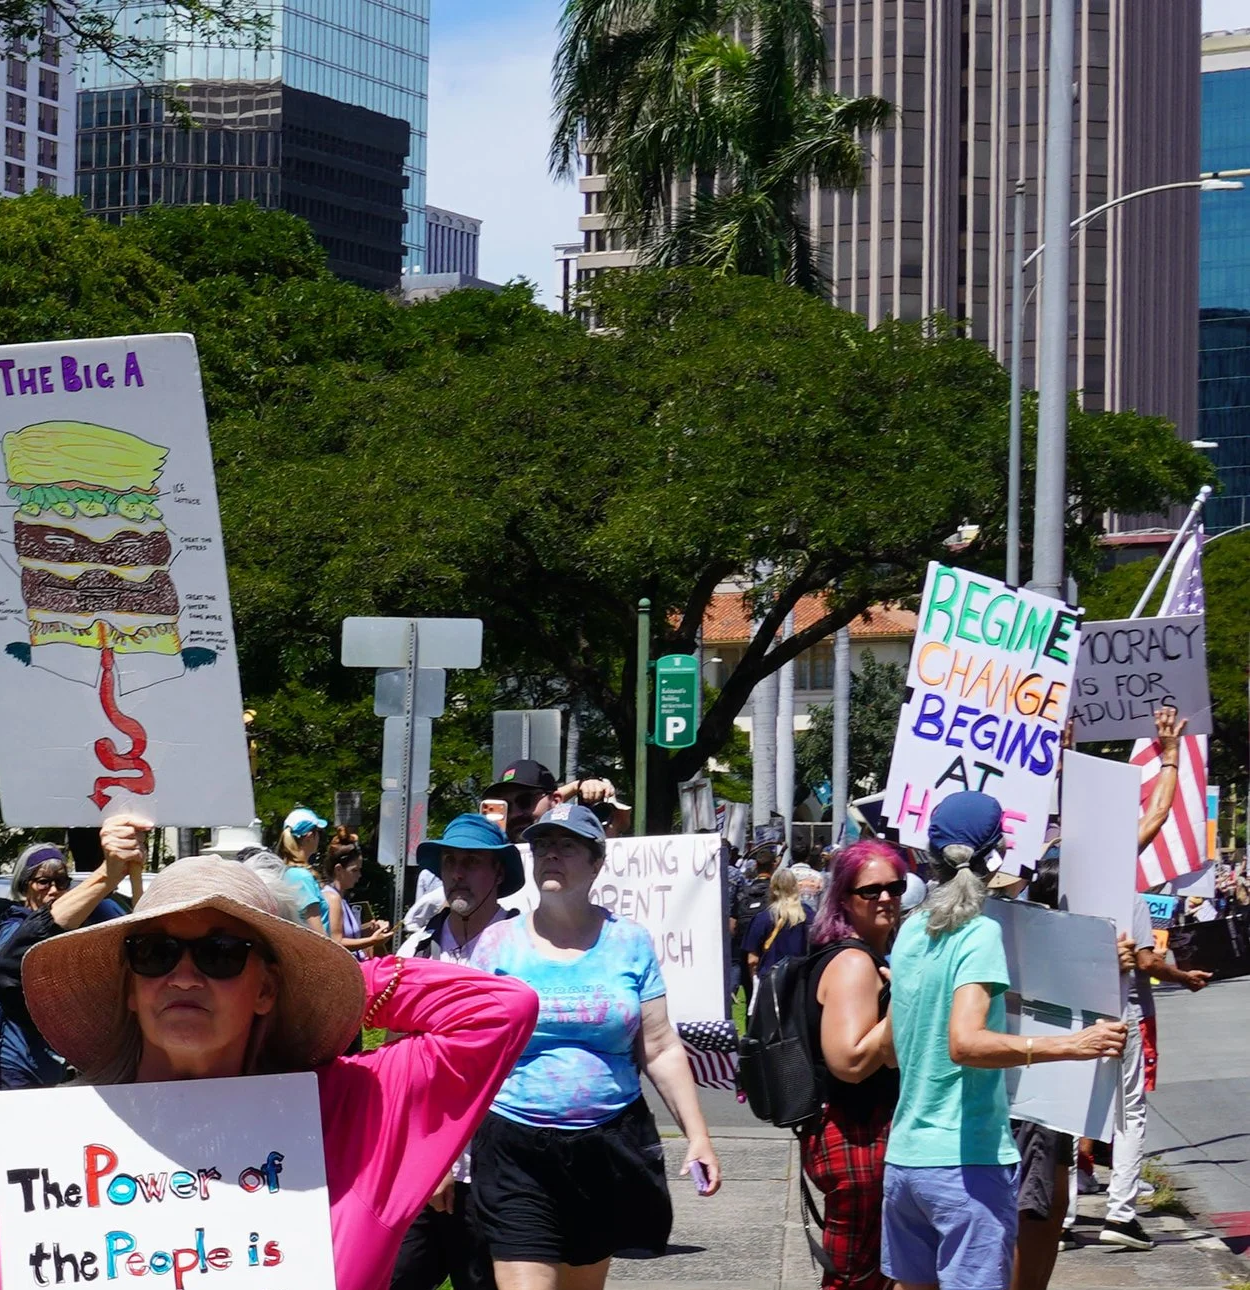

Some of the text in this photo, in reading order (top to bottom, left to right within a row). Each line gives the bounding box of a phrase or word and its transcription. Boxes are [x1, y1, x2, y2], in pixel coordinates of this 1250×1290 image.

[61, 355, 115, 393] BIG
[124, 351, 145, 388] A
[922, 564, 1079, 669] REGIME
[916, 640, 1067, 725] CHANGE
[1075, 671, 1172, 698] IS FOR
[665, 716, 687, 742] P
[1068, 694, 1179, 727] ADULTS
[910, 692, 1060, 777] BEGINS
[935, 755, 1004, 793] AT
[896, 782, 1028, 851] HE
[603, 840, 679, 878] CKING
[1147, 901, 1168, 917] CH
[7, 1143, 285, 1214] The Power of
[29, 1241, 101, 1287] the
[246, 1231, 285, 1268] is
